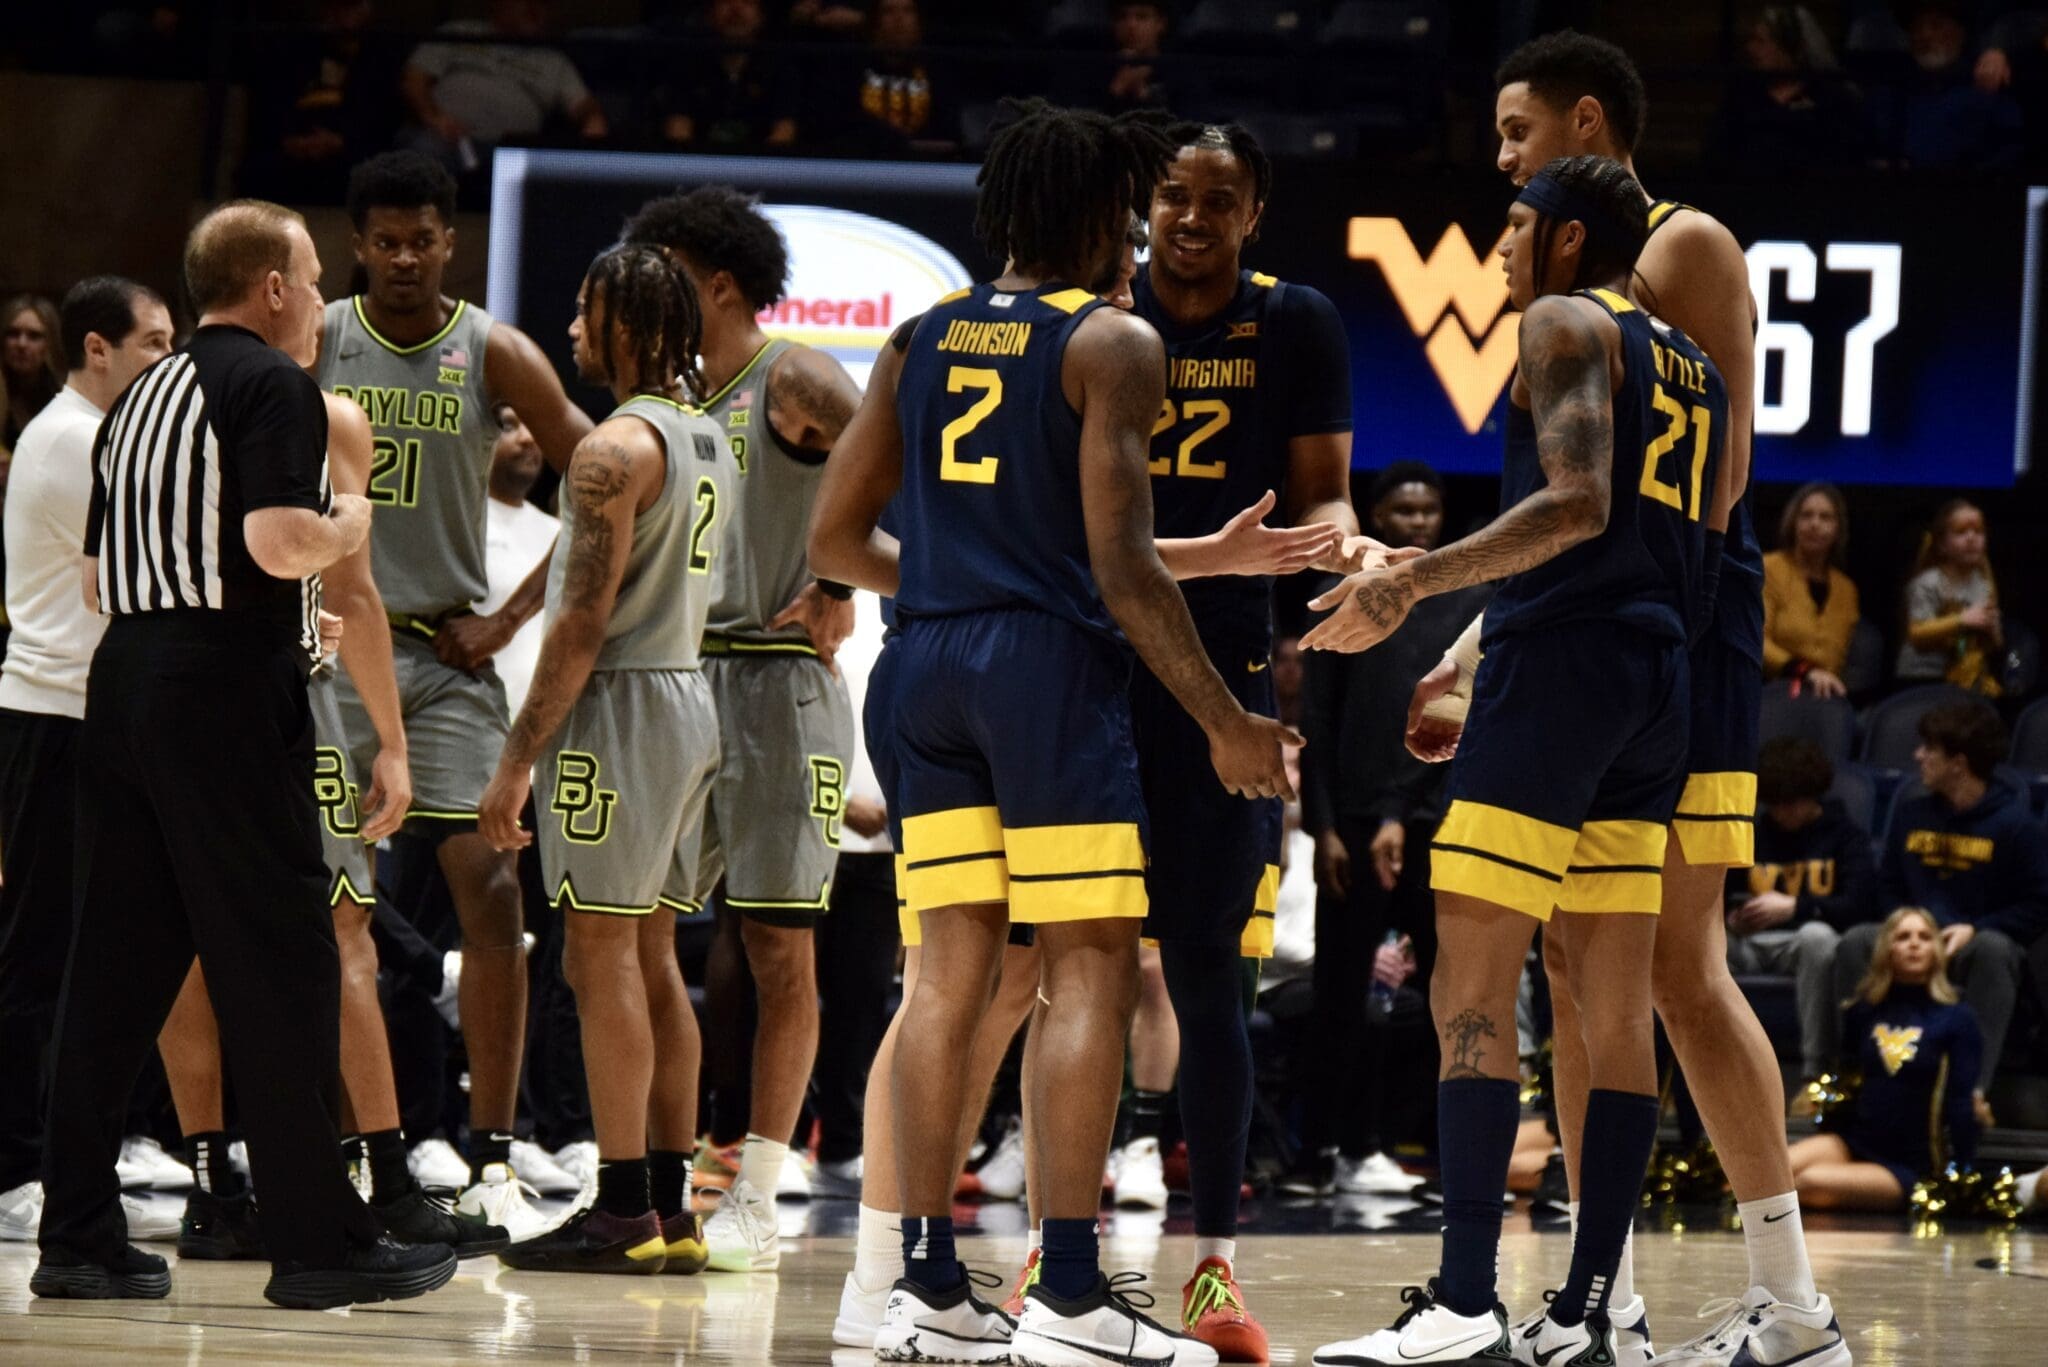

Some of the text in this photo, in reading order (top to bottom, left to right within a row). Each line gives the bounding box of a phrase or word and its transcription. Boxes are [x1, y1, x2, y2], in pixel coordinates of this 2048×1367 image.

[937, 319, 1032, 357] JOHNSON
[1171, 357, 1256, 388] VIRGINIA
[1745, 241, 1901, 436] 67
[366, 436, 422, 508] 21
[940, 366, 1003, 485] 2
[1148, 398, 1231, 479] 22
[1639, 382, 1711, 522] 21
[687, 475, 717, 576] 2
[551, 750, 617, 845] BU
